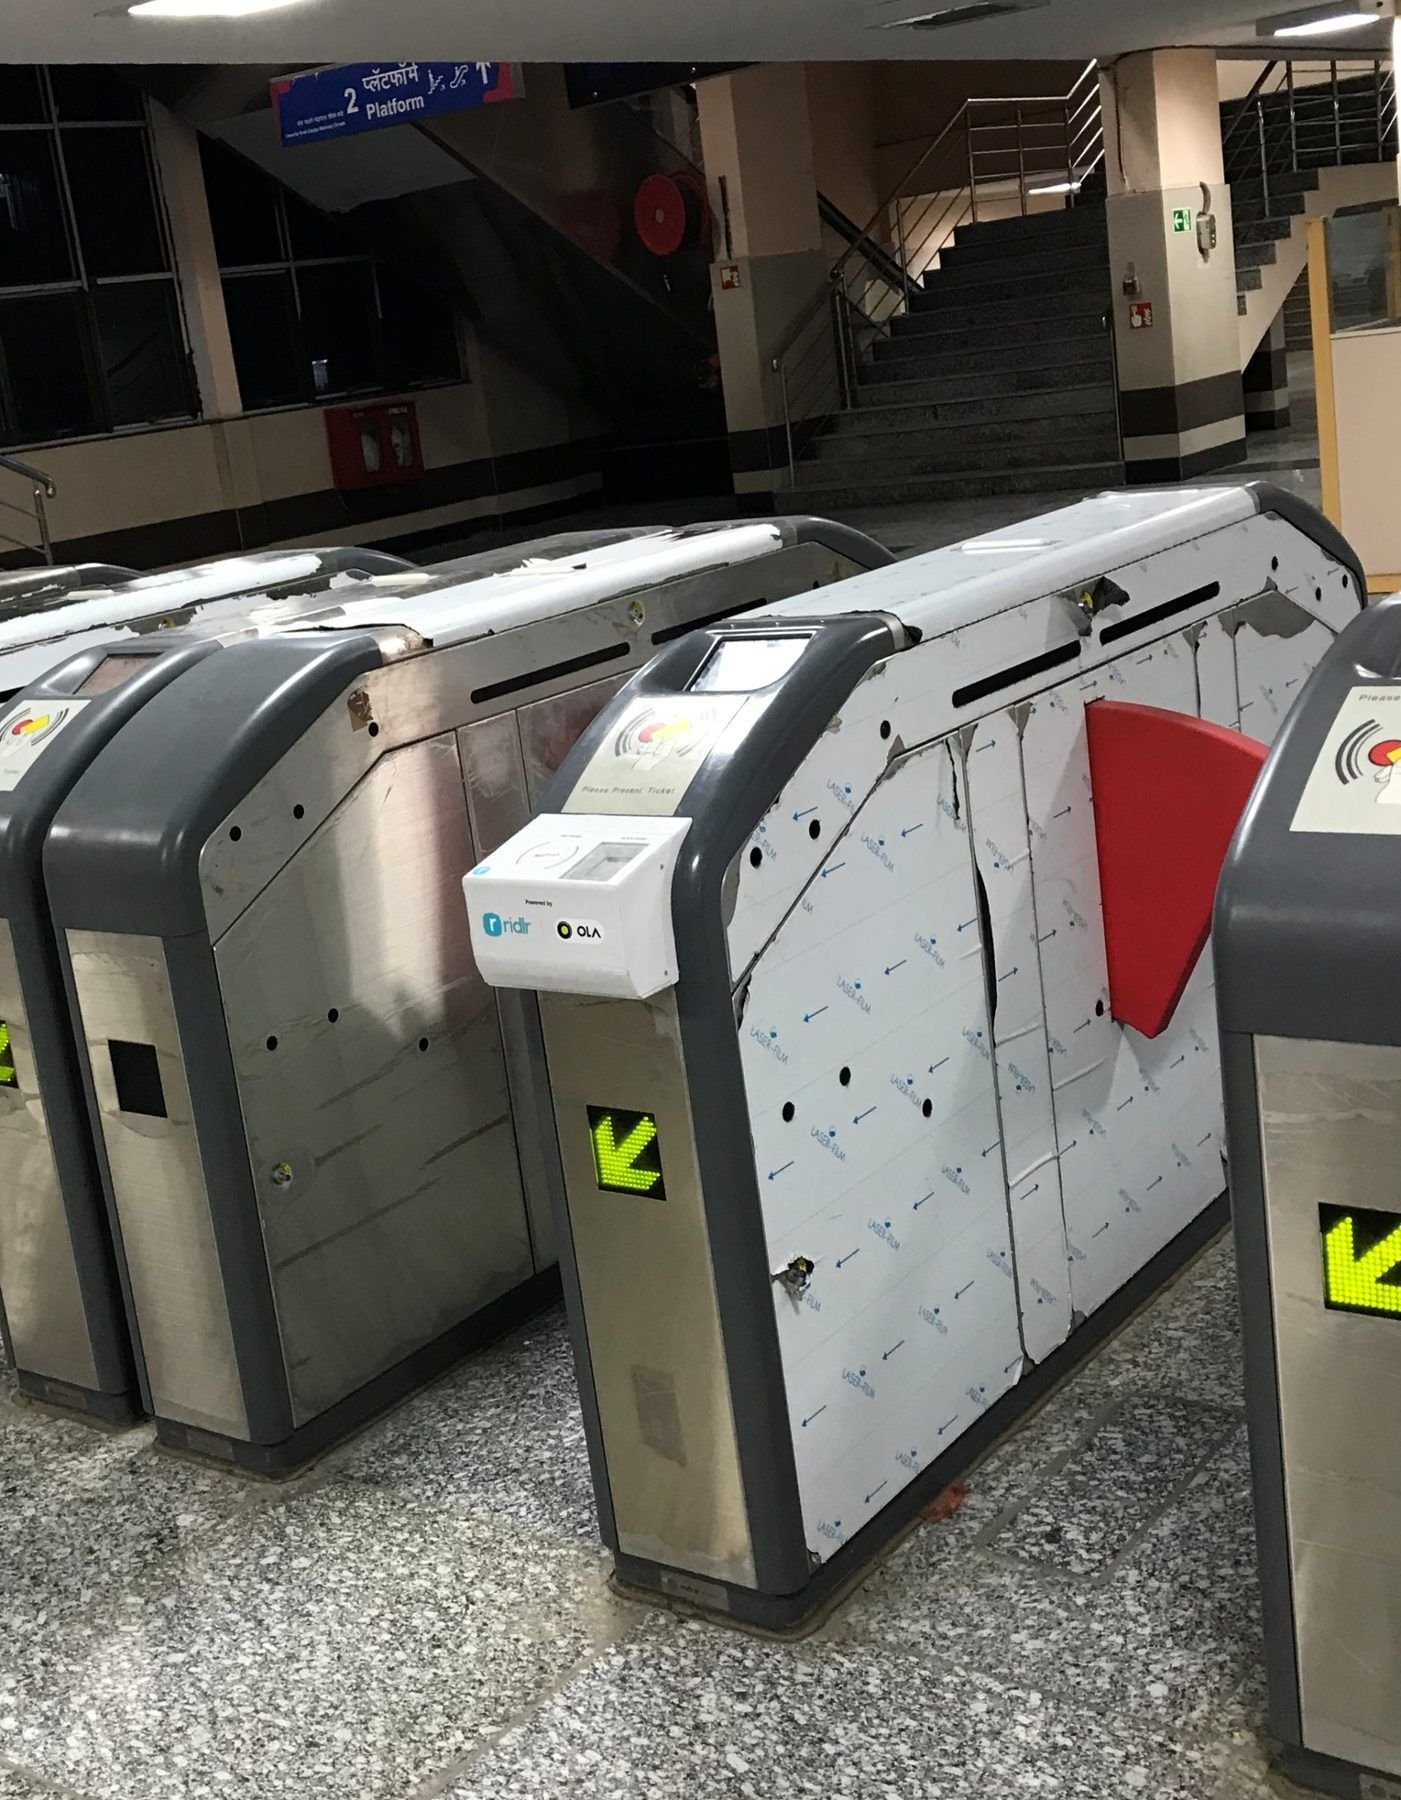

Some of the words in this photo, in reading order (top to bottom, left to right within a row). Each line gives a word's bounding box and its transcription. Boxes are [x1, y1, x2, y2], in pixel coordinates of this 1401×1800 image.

[344, 87, 360, 114] 2
[366, 95, 425, 120] Platform
[581, 785, 609, 794] Please
[610, 786, 642, 795] Present
[648, 786, 675, 795] Ticket
[503, 916, 531, 935] ridlr
[576, 925, 602, 939] OLA
[836, 975, 871, 1015] LASER-FILM
[750, 1025, 789, 1064] LASER-FILM
[810, 1125, 846, 1162] LASER-FILM
[867, 1217, 901, 1251] LASER-FILM
[841, 1367, 876, 1400] LASER-FILM
